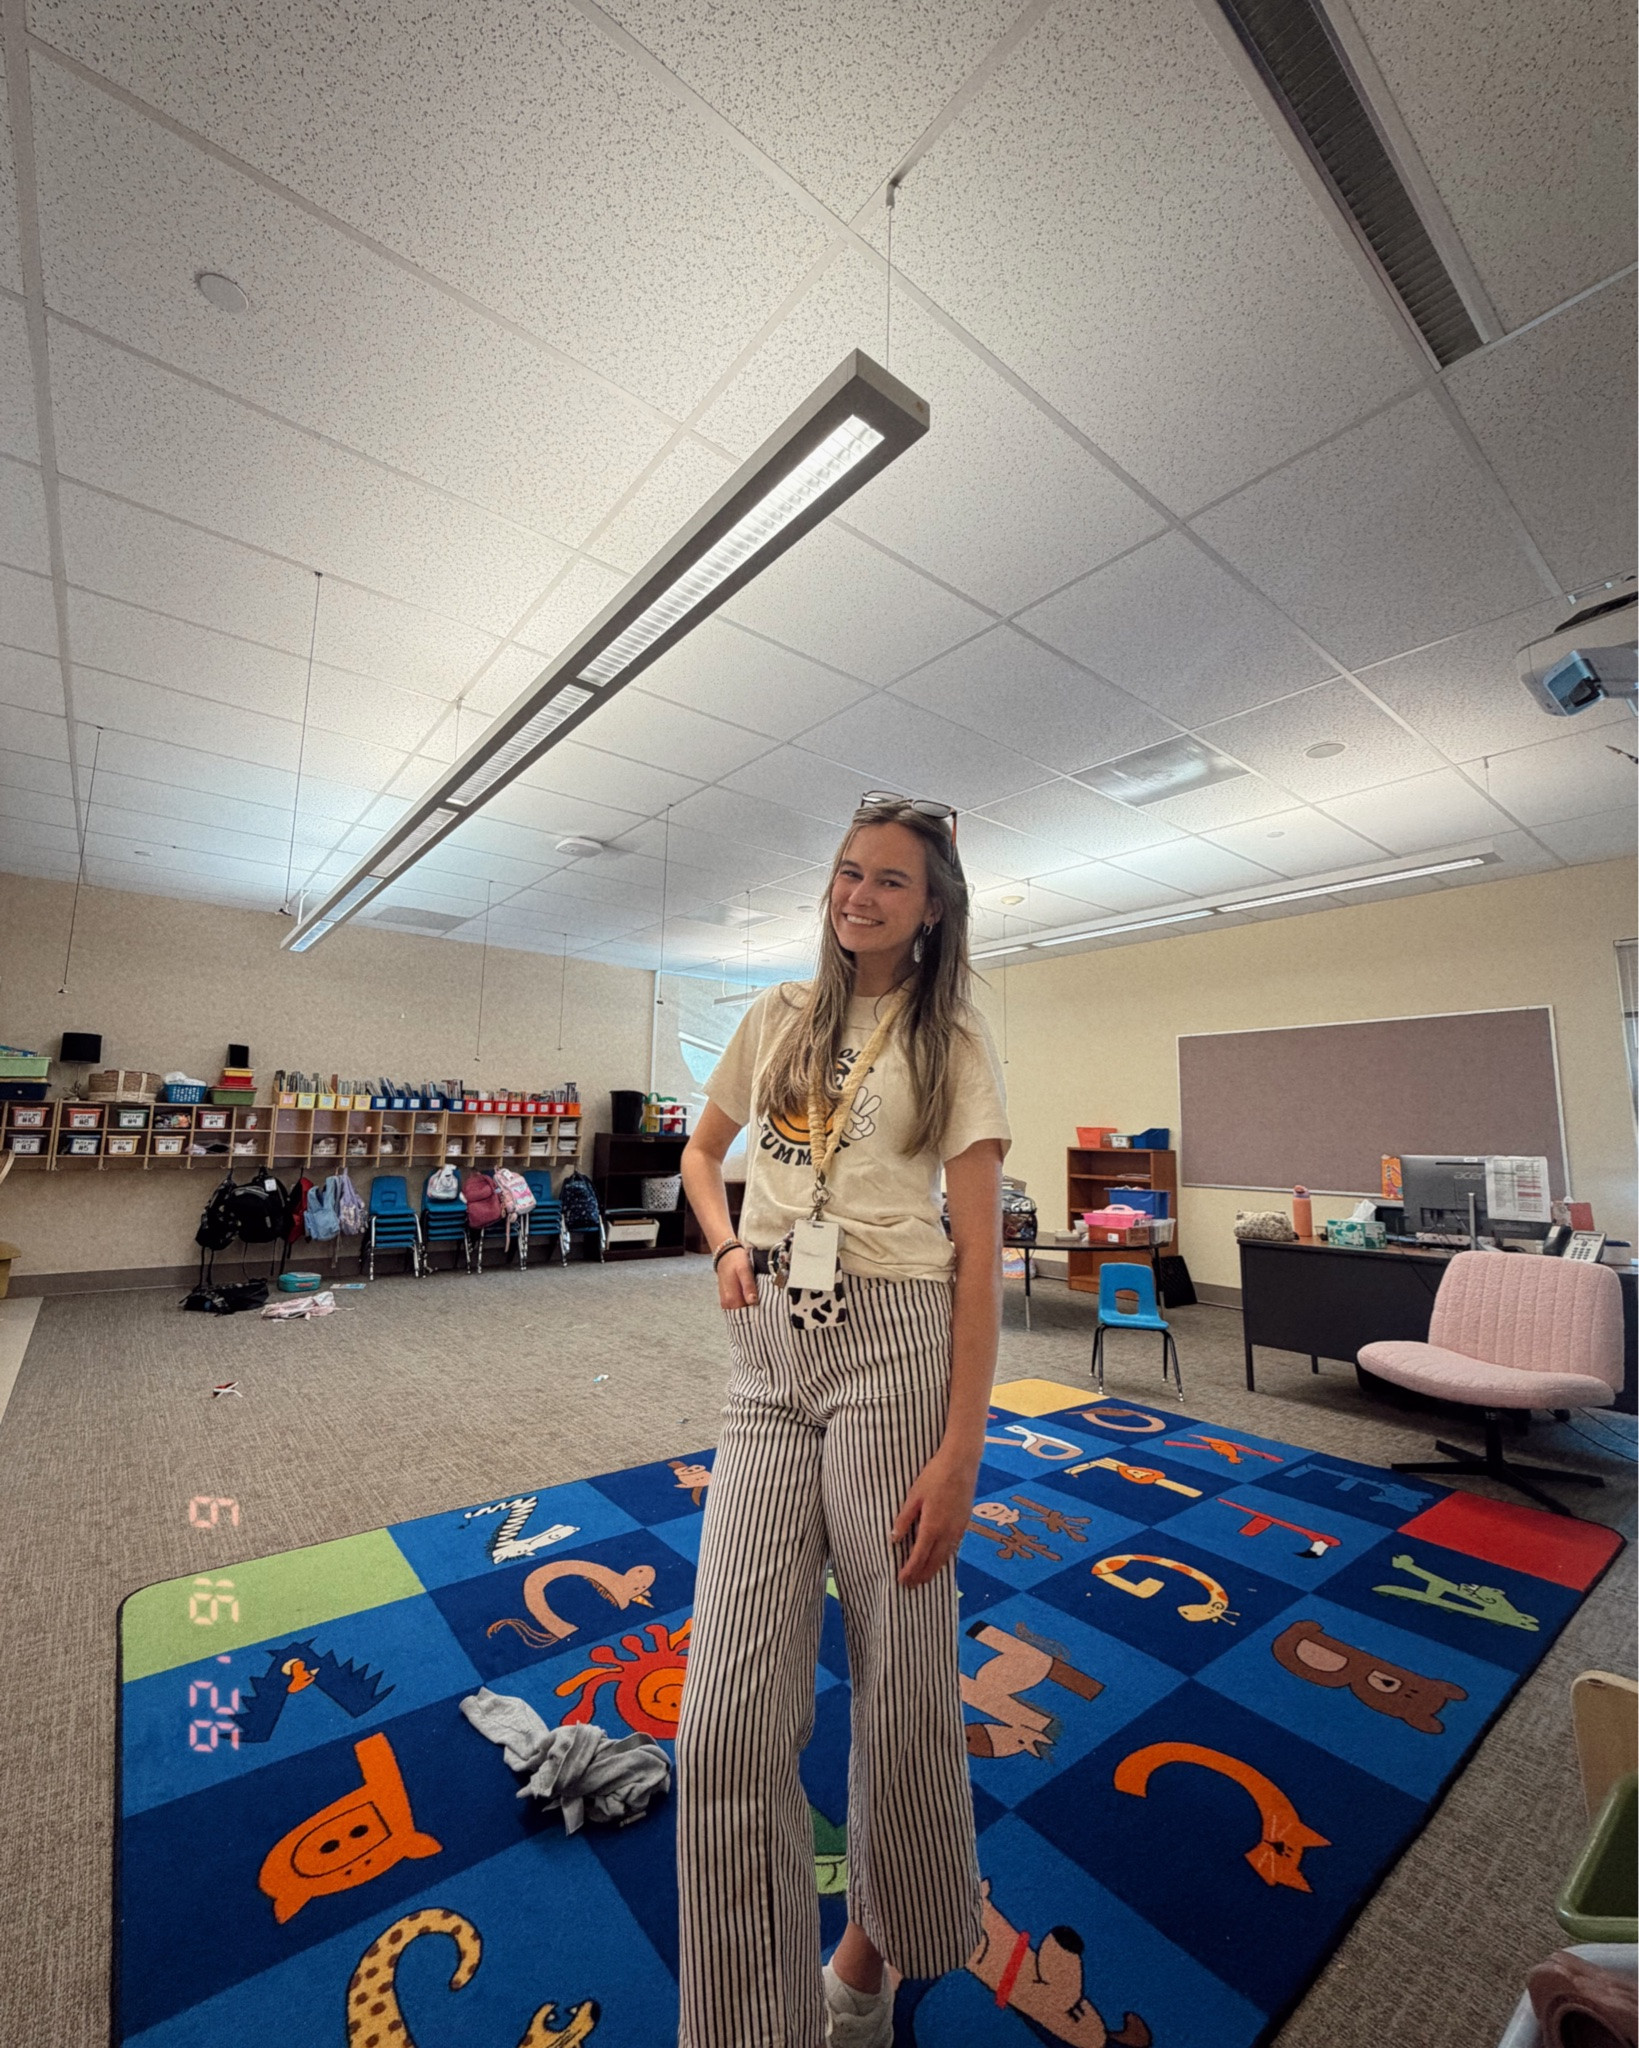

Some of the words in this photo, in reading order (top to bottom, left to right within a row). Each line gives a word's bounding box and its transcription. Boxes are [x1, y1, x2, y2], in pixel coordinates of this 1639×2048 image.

[760, 1123, 850, 1166] UMM
[1453, 1171, 1486, 1180] acer
[1091, 1553, 1242, 1627] G
[1271, 1619, 1469, 1735] B
[1114, 1741, 1332, 1894] C
